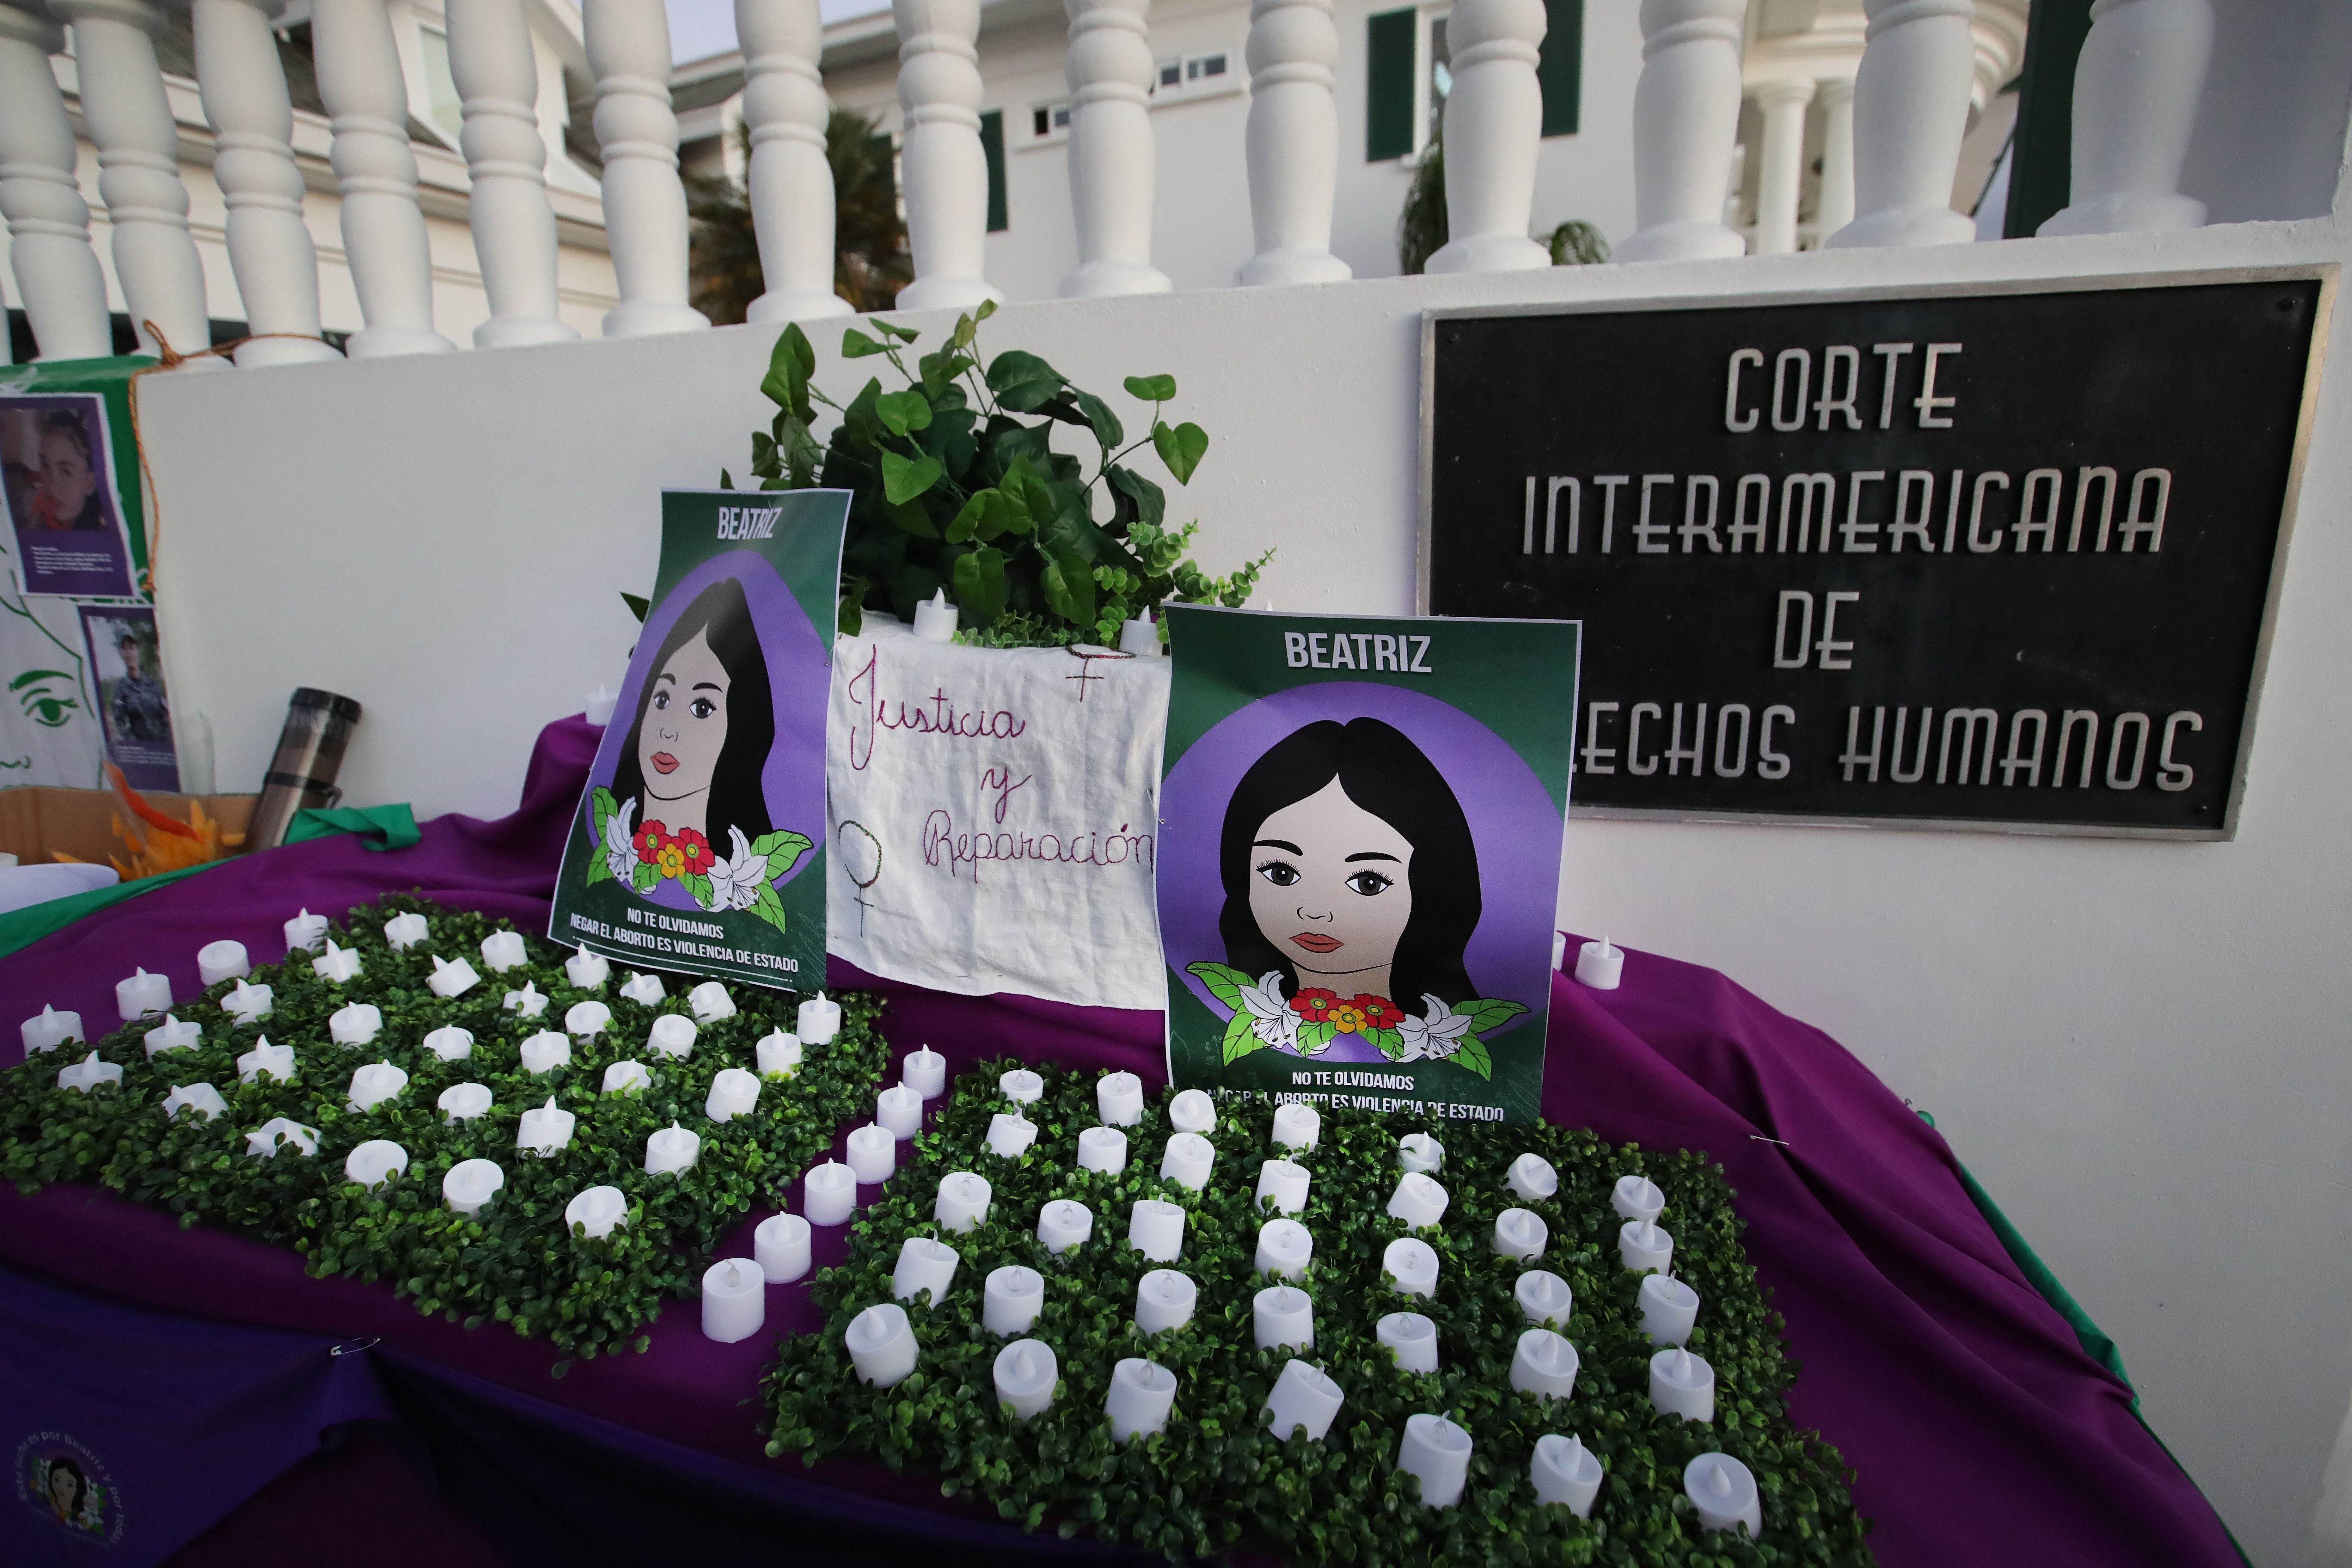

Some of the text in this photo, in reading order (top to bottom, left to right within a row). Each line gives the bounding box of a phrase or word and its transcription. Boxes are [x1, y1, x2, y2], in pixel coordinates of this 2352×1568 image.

[1725, 343, 1963, 432] CORTE
[717, 508, 782, 540] BEATRIZ
[1522, 467, 2172, 554] INTERAMERICANA
[1774, 591, 1860, 670] DE
[1284, 632, 1432, 673] BEATRIZ
[848, 643, 1026, 770] Justicia
[1573, 701, 2203, 791] ECHOS HUMANOS
[980, 766, 1033, 824] y
[923, 810, 1154, 884] Reparación
[570, 913, 799, 973] NEGAR EL ABORTO ES VIOLENCIA DE ESTADO
[627, 907, 724, 940] NO TE OLVIDAMOS
[1292, 1071, 1415, 1091] NO TE OLVIDAMOS
[1332, 1094, 1349, 1109] ES
[1449, 1103, 1504, 1122] ESTADO
[41, 1430, 61, 1442] por
[64, 1434, 105, 1472] Beatriz
[103, 1474, 112, 1482] y
[109, 1486, 123, 1510] por
[110, 1513, 125, 1545] todas
